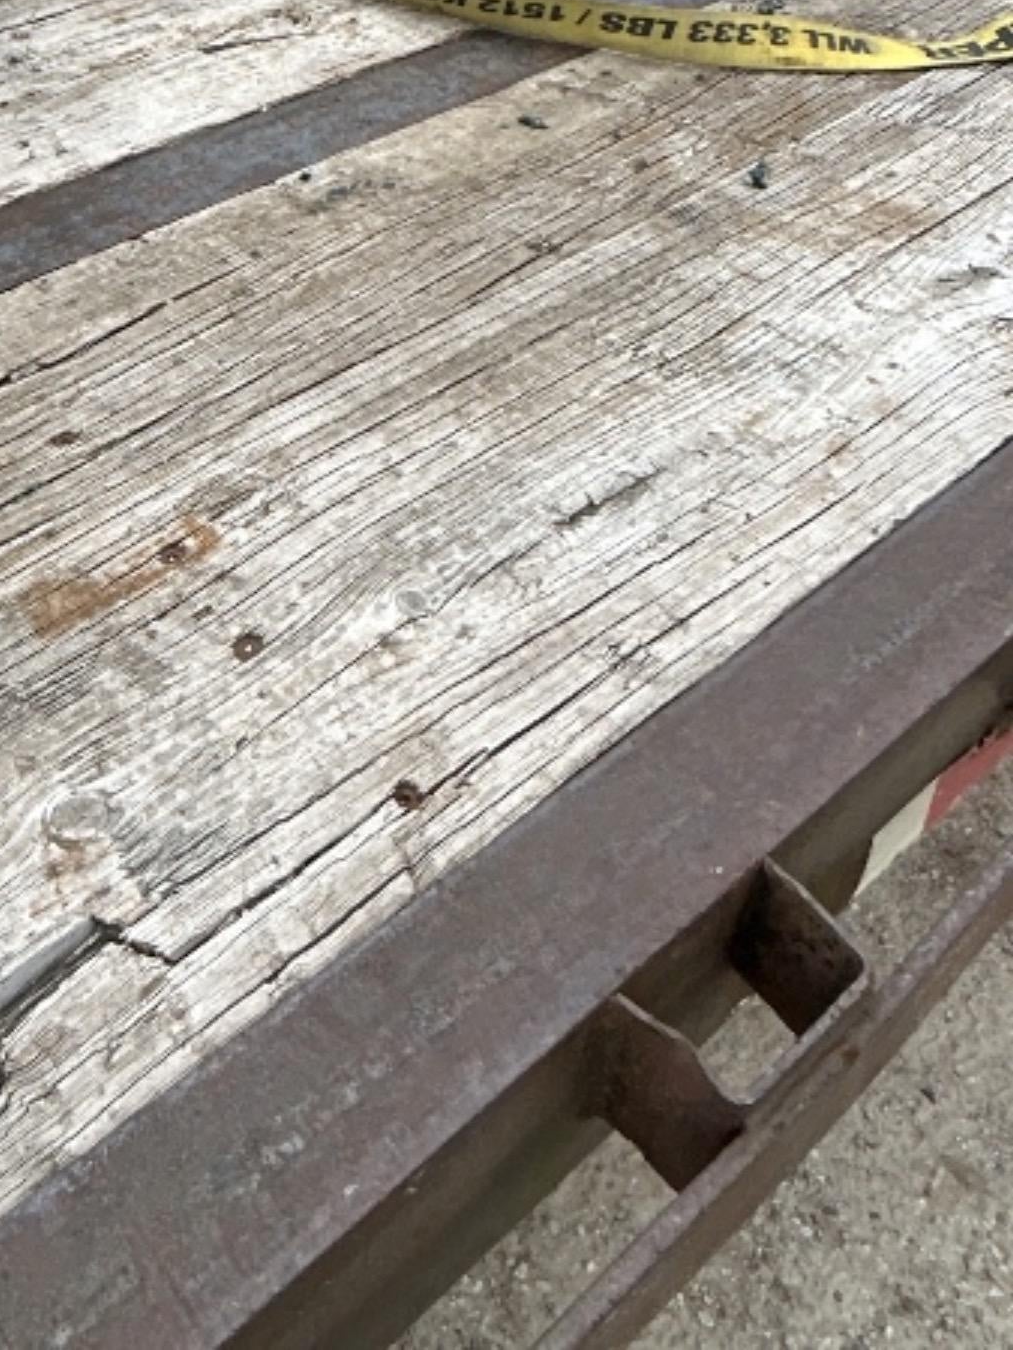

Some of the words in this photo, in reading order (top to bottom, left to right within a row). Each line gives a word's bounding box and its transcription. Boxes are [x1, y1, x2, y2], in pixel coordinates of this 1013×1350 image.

[575, 8, 592, 25] /
[599, 11, 678, 39] LBS
[688, 20, 791, 45] 3,333
[802, 29, 872, 54] WLL
